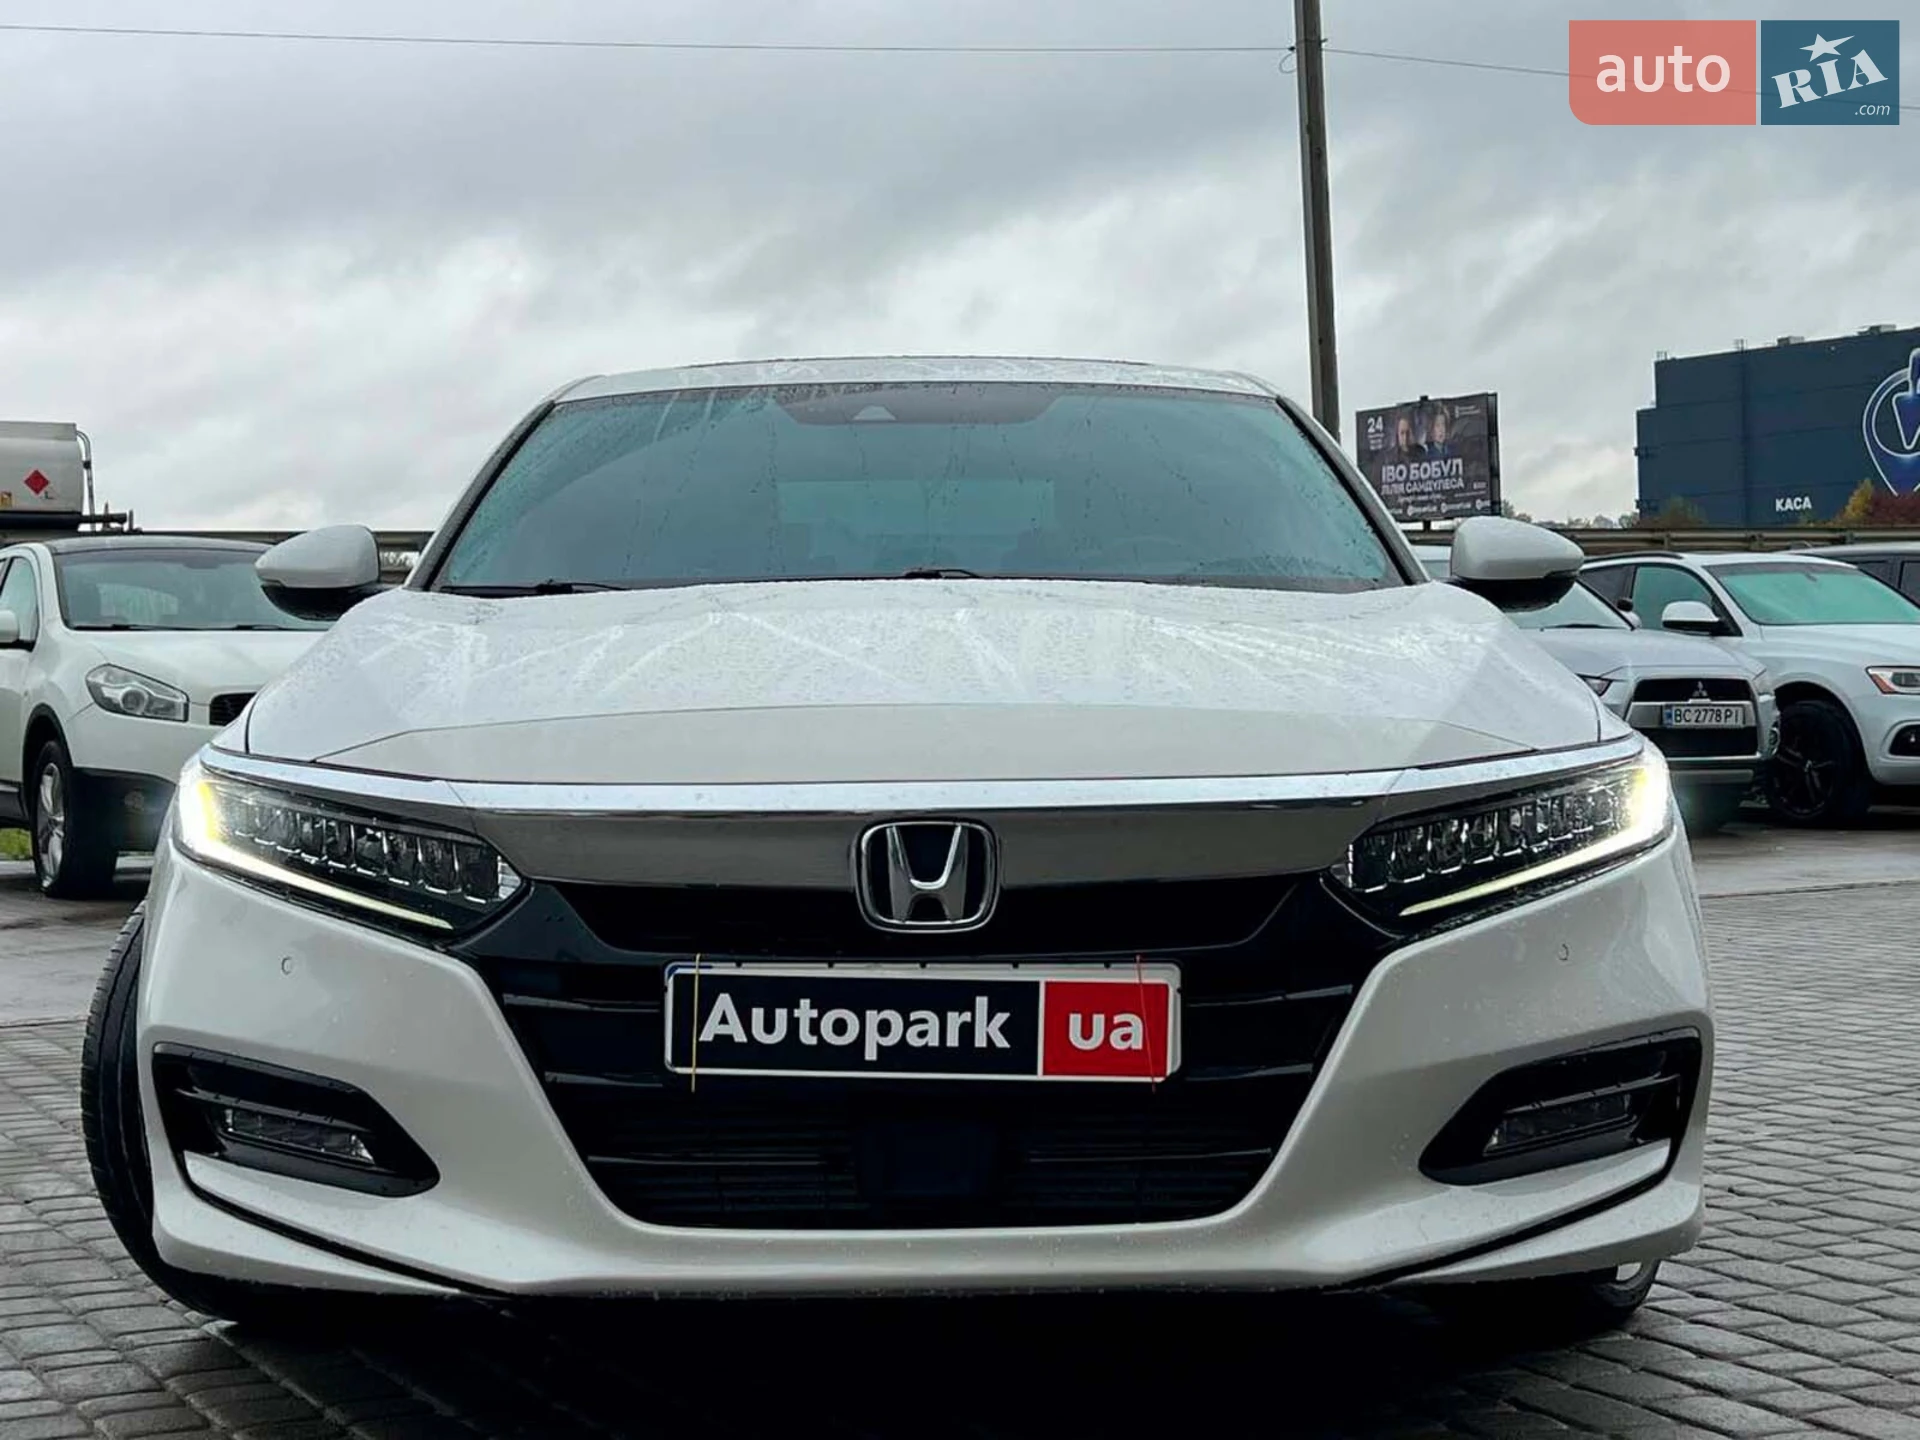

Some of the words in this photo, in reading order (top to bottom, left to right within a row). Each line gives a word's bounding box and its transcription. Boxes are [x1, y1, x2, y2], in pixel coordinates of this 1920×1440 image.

[1367, 416, 1384, 433] 24
[1381, 464, 1407, 483] ІВО
[1409, 458, 1463, 481] БОБУЛ
[1775, 496, 1813, 512] КАСА
[1674, 708, 1692, 723] BC
[1694, 708, 1723, 723] 2778
[698, 993, 1012, 1061] Autopark
[1068, 1012, 1144, 1050] ua
